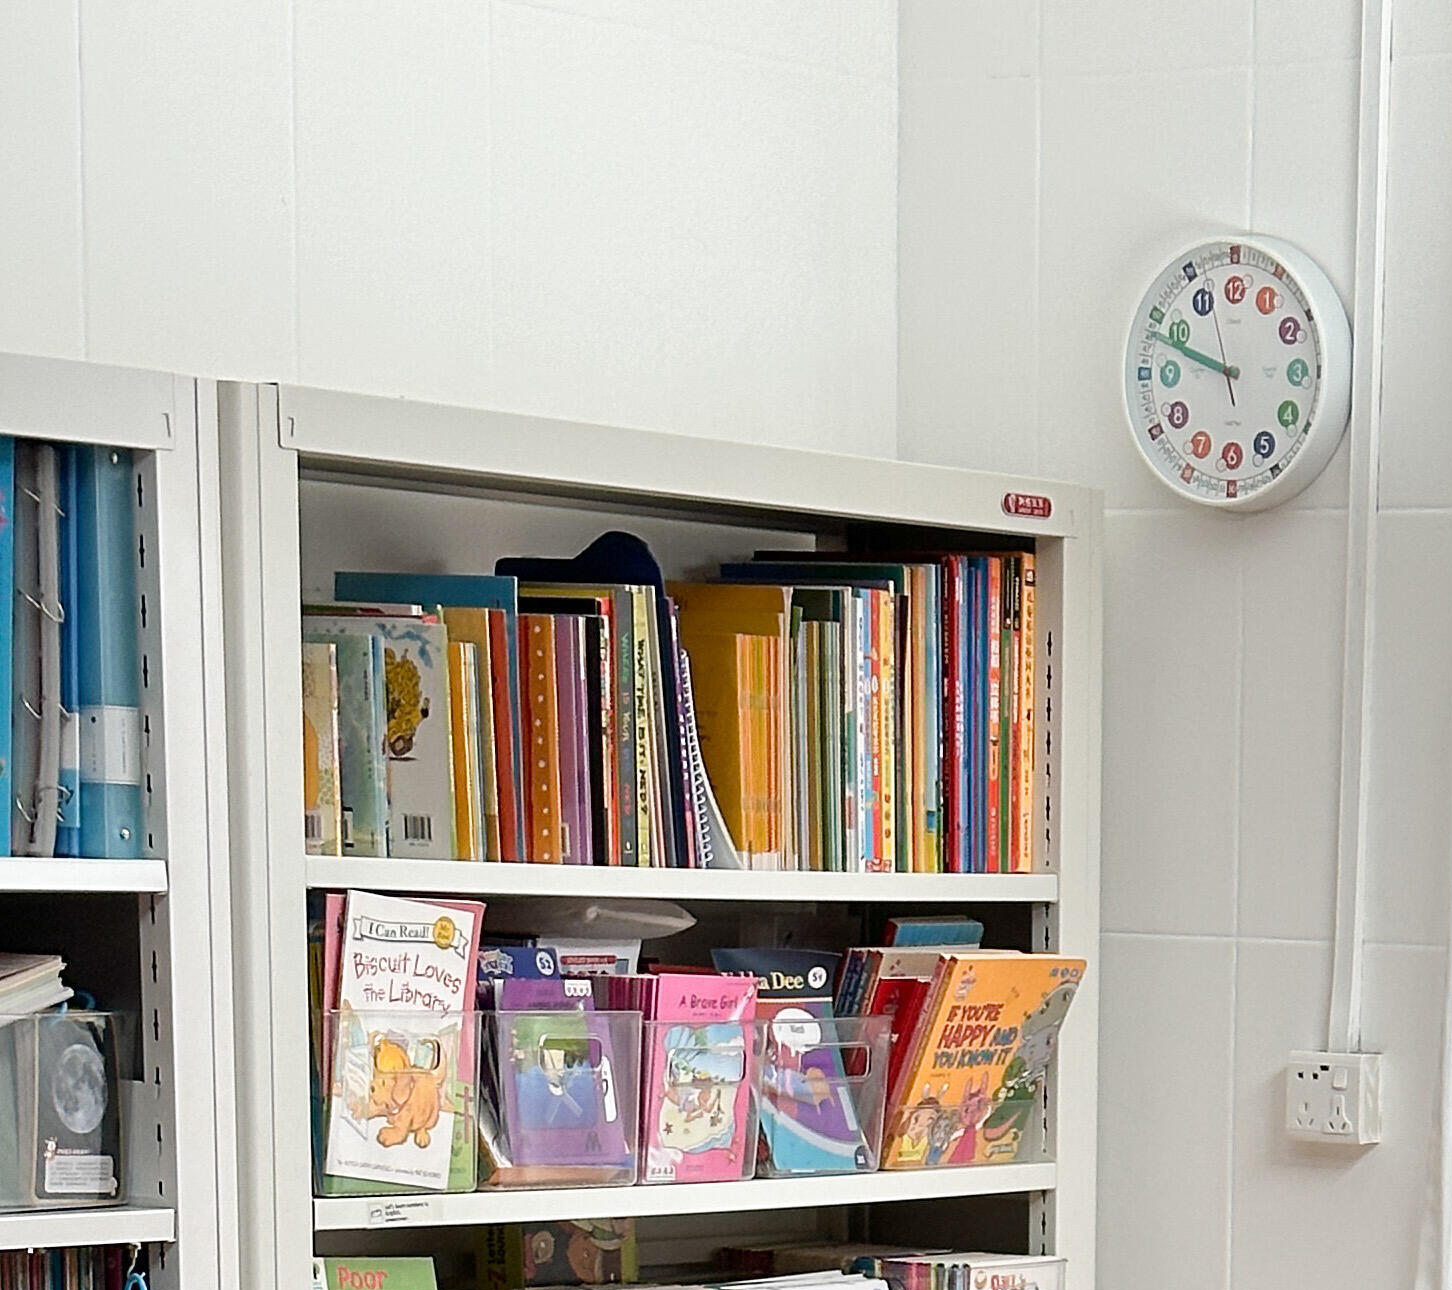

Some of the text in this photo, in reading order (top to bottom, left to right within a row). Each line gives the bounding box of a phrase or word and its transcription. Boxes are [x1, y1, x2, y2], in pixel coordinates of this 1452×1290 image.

[1228, 282, 1243, 300] 12
[1200, 294, 1212, 311] 11
[1264, 294, 1270, 308] 1
[1171, 325, 1187, 342] 10
[1285, 322, 1295, 340] 2
[1166, 366, 1174, 383] 9
[1294, 364, 1301, 381] 3
[1173, 406, 1183, 424] 8
[1283, 406, 1293, 423] 4
[1197, 437, 1205, 453] 7
[1260, 436, 1270, 454] 5
[1228, 447, 1237, 464] 6
[376, 924, 397, 938] Can
[399, 925, 430, 939] Read!
[353, 952, 412, 979] Biscuit
[413, 954, 461, 994] Loves
[770, 971, 805, 989] Dee
[389, 978, 451, 1019] Library
[679, 994, 739, 1009] A Brave Girl
[937, 1024, 996, 1049] HAPPY
[337, 1266, 388, 1290] Poor
